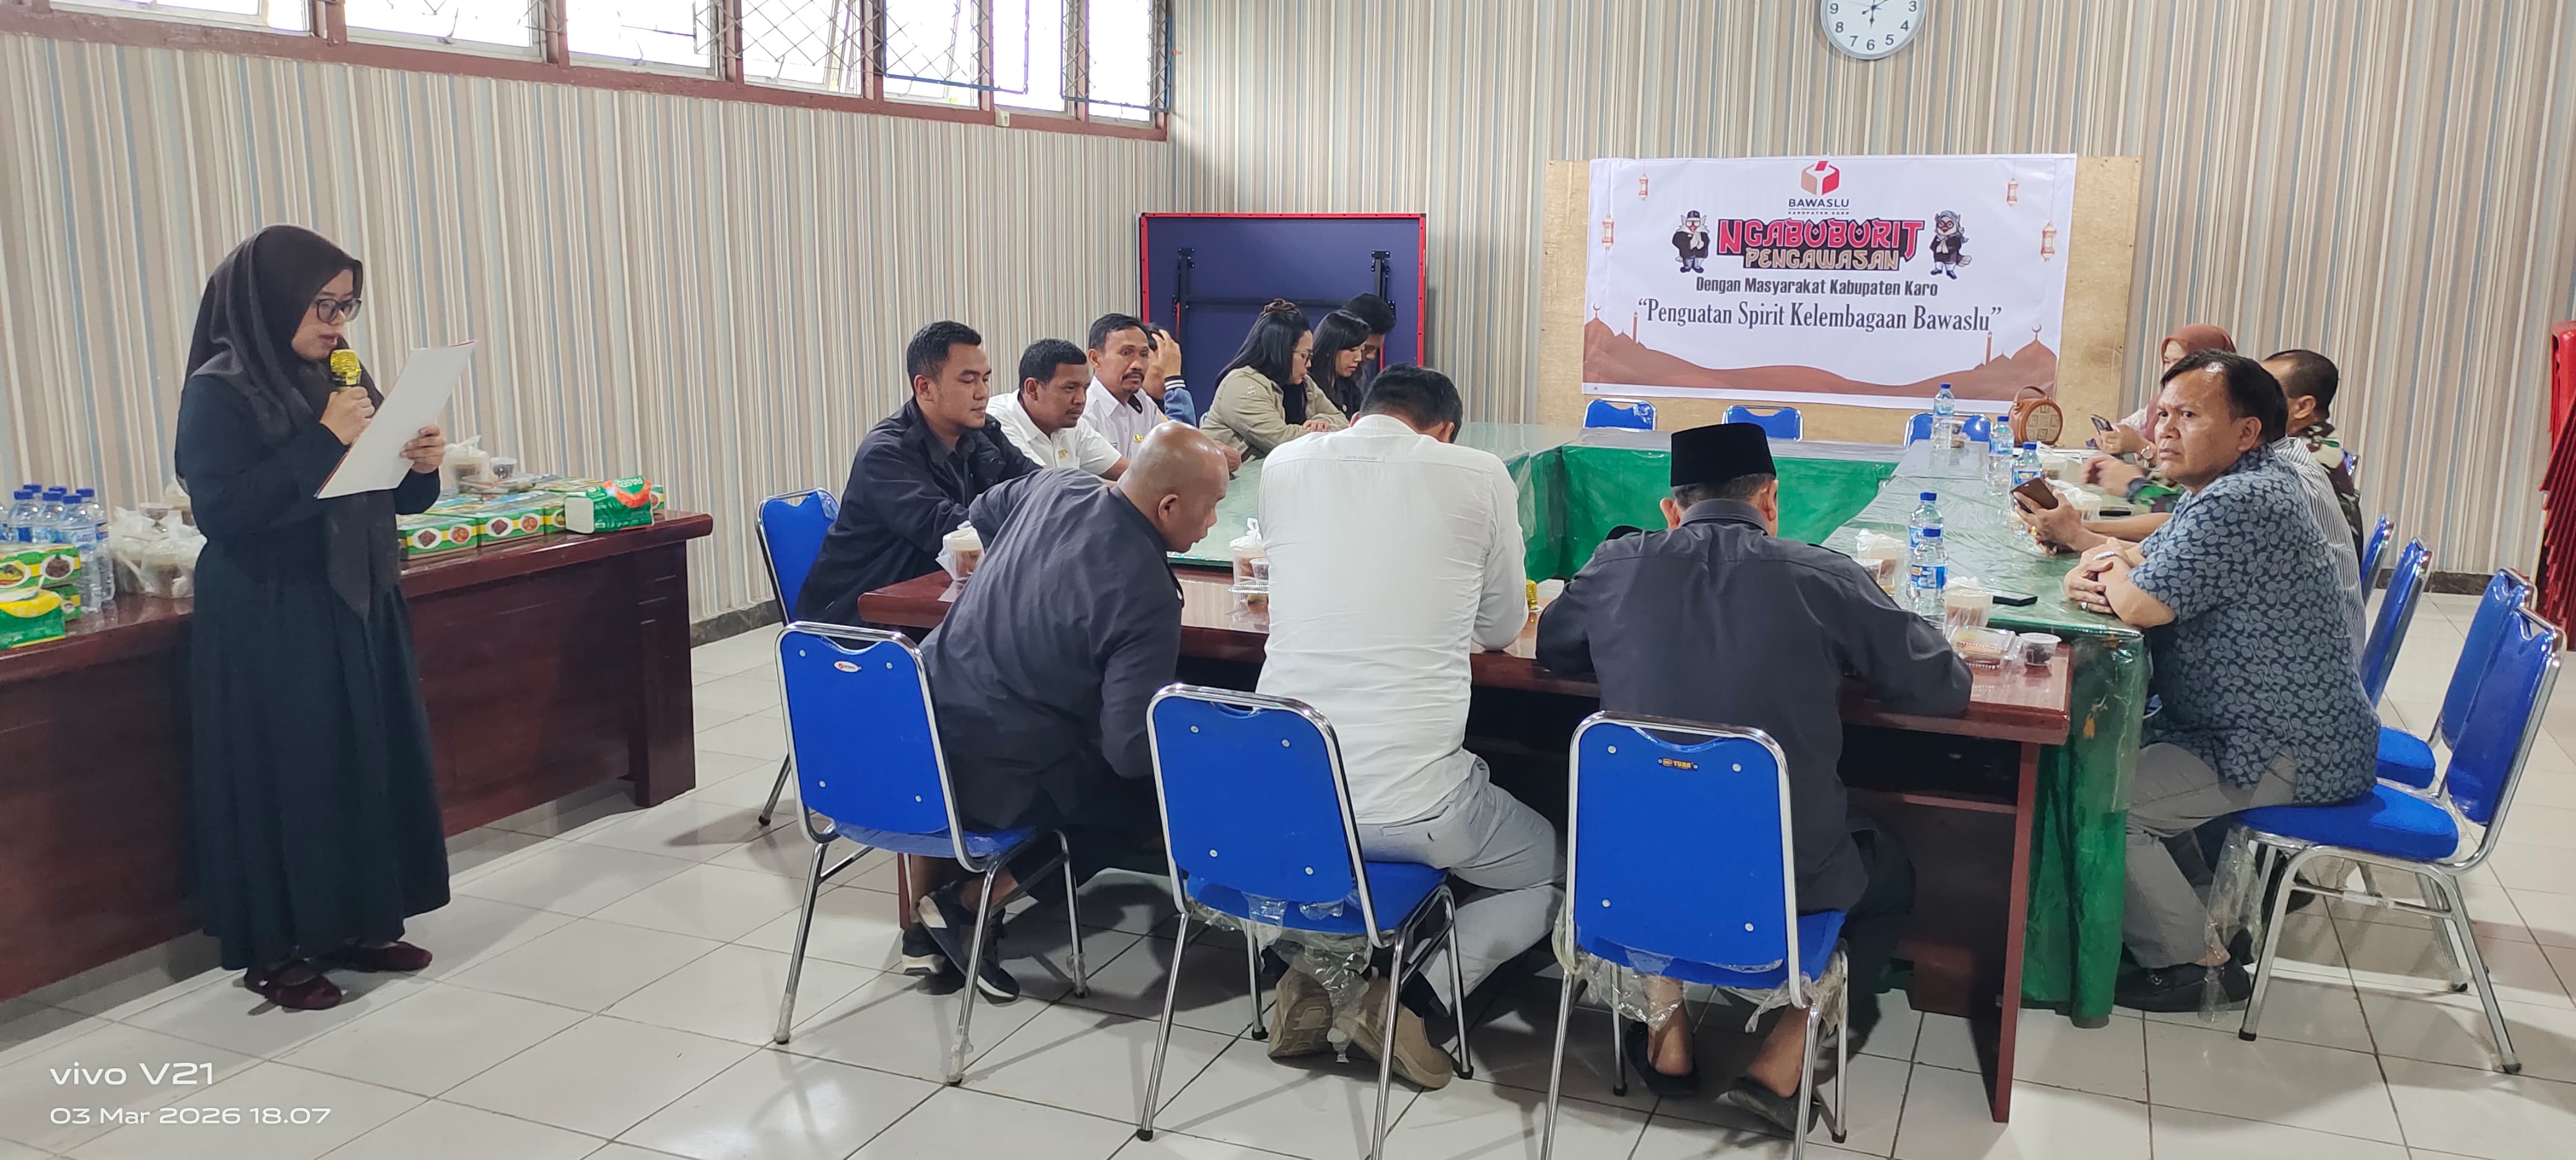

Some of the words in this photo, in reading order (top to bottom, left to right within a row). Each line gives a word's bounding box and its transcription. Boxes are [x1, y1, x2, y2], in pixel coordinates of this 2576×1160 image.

[1830, 3, 1838, 14] 9
[1908, 1, 1917, 12] 3
[1835, 22, 1844, 33] 8
[1900, 20, 1910, 32] 4
[1850, 35, 1858, 47] 7
[1866, 40, 1875, 51] 6
[1885, 35, 1894, 46] 5
[1788, 199, 1849, 207] BAWASLU
[1718, 219, 1924, 259] NGABUBURIT
[1745, 248, 1899, 270] PENGAWASAN
[1696, 277, 1741, 294] Dengan
[1745, 277, 1825, 295] Masyarakat
[1830, 280, 1900, 297] Kabupaten
[1905, 280, 1938, 296] Karo
[1638, 298, 1732, 326] “Penguatan
[1738, 301, 1785, 329] Spirit
[1790, 302, 1907, 332] Kelembagaan
[1913, 305, 2002, 331] Bawaslu”
